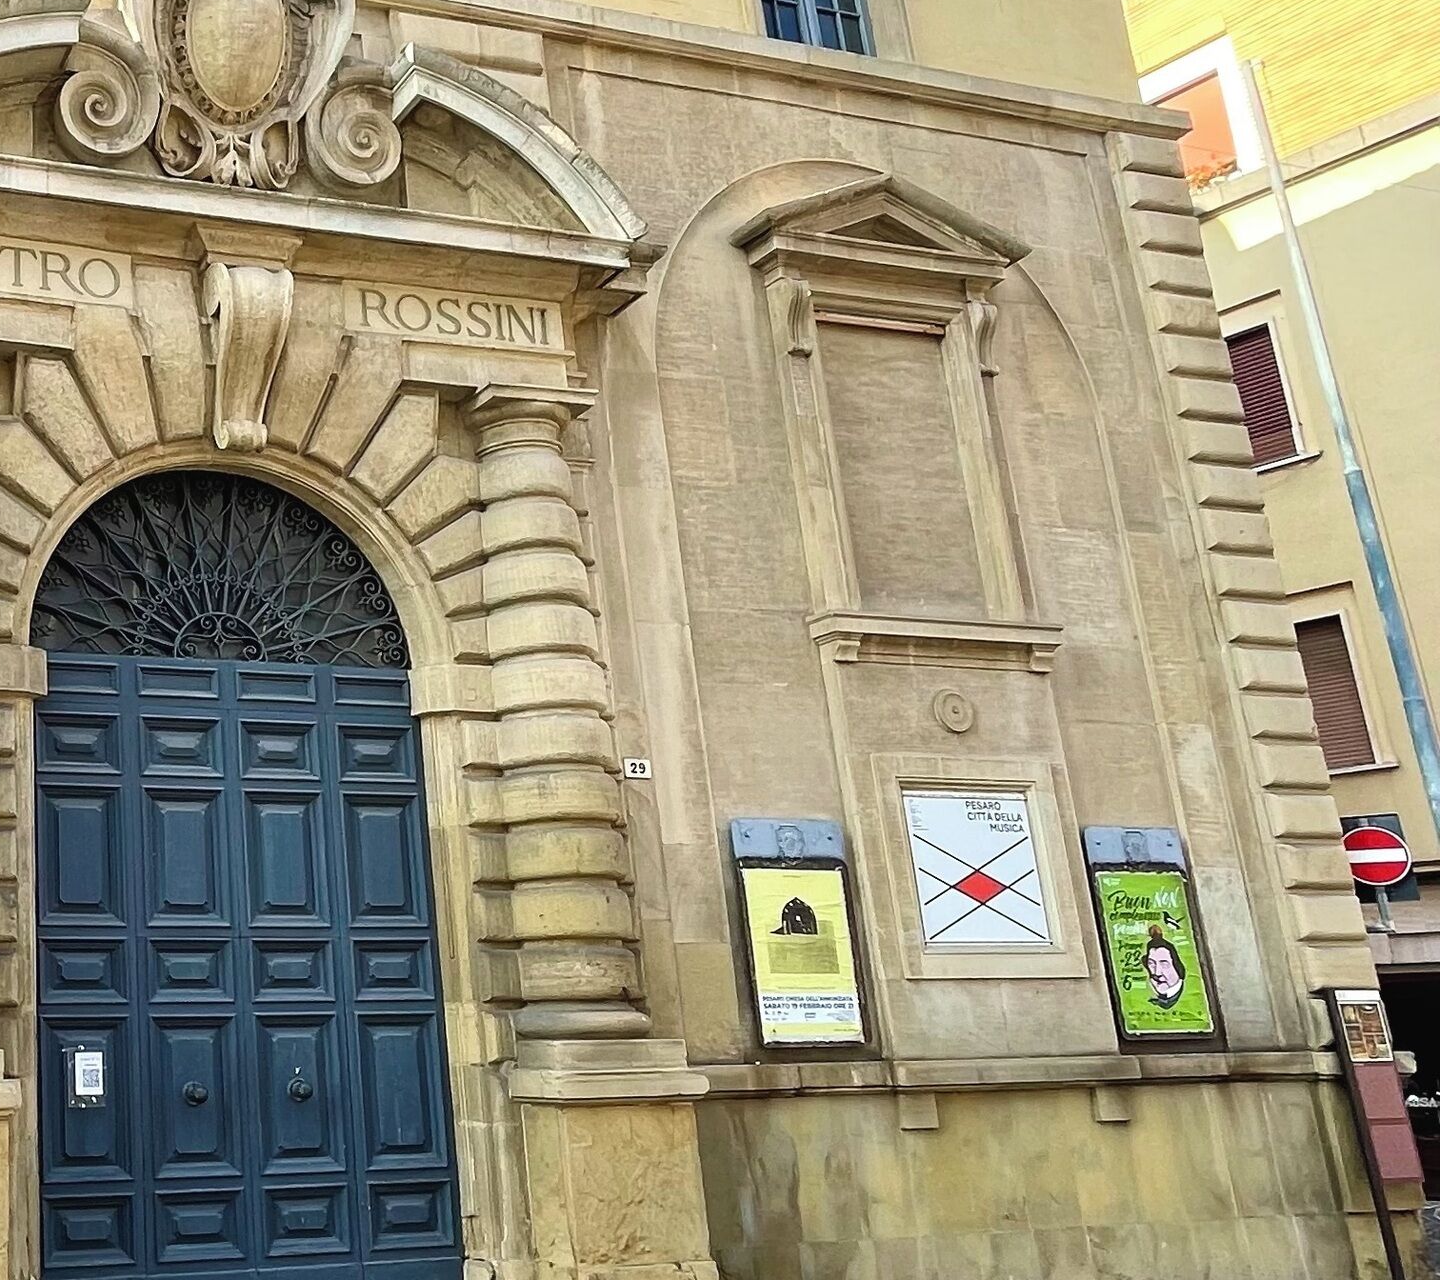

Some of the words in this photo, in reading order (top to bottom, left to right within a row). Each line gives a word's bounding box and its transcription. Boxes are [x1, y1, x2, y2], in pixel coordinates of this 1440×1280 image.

[359, 288, 549, 345] ROSSINI
[630, 762, 646, 774] 29
[965, 800, 1001, 810] PESARO
[994, 813, 1023, 822] DELLA
[989, 823, 1025, 832] MUSICA
